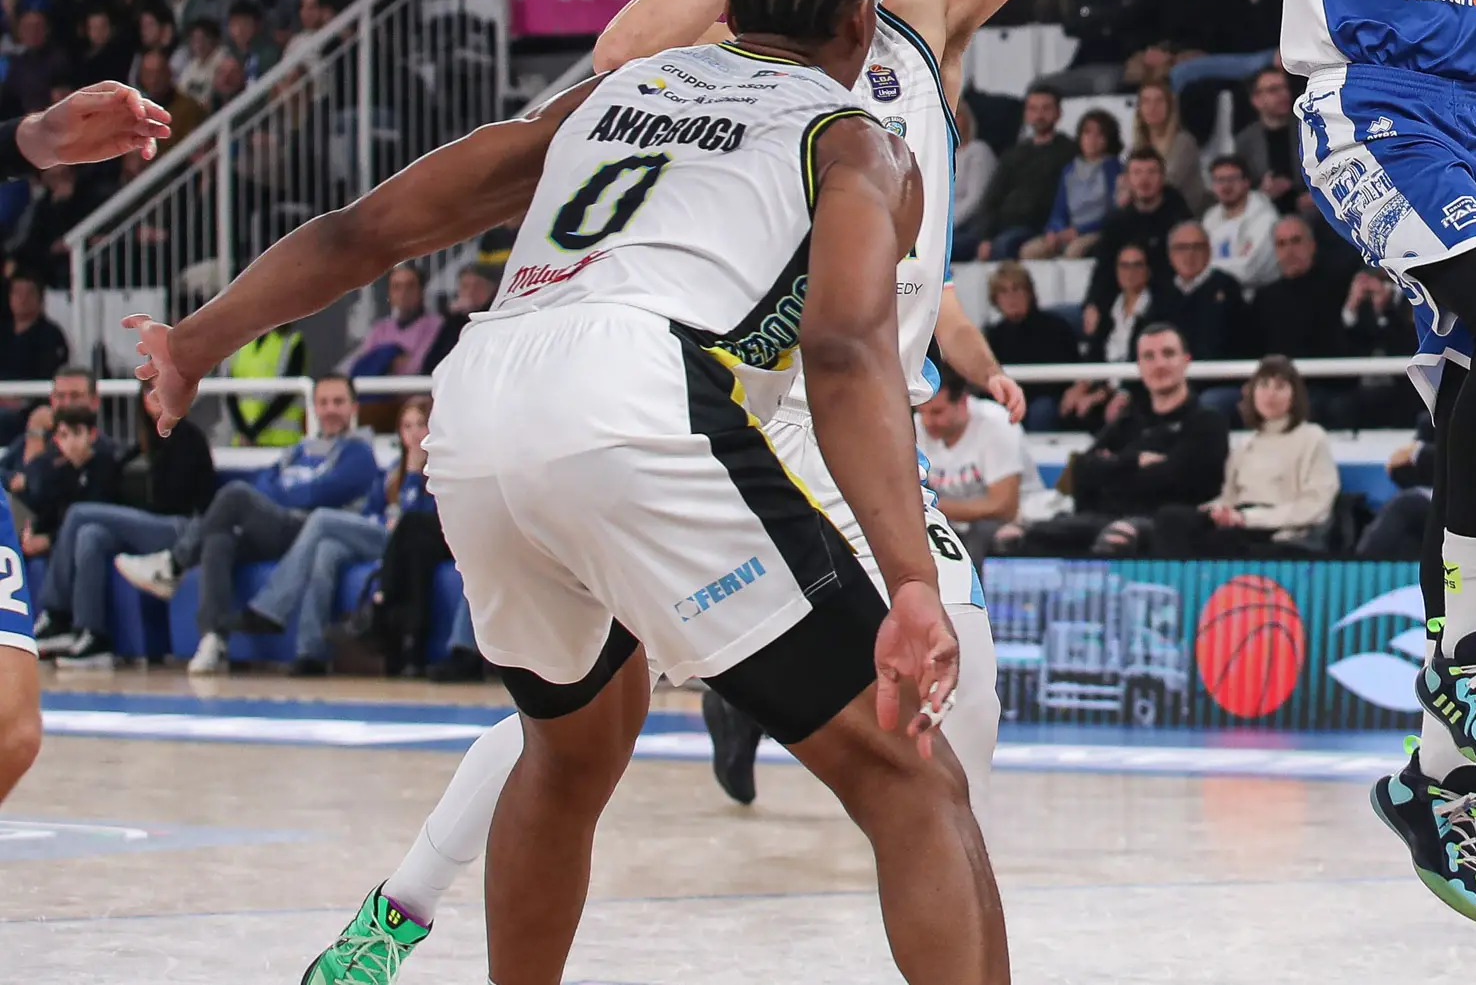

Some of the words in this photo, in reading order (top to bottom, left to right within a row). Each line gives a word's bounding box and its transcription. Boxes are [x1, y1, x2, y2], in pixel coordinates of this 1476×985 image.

[661, 64, 715, 91] Gruppo
[546, 151, 671, 252] 0
[0, 546, 29, 615] 2
[693, 556, 767, 611] FERVI
